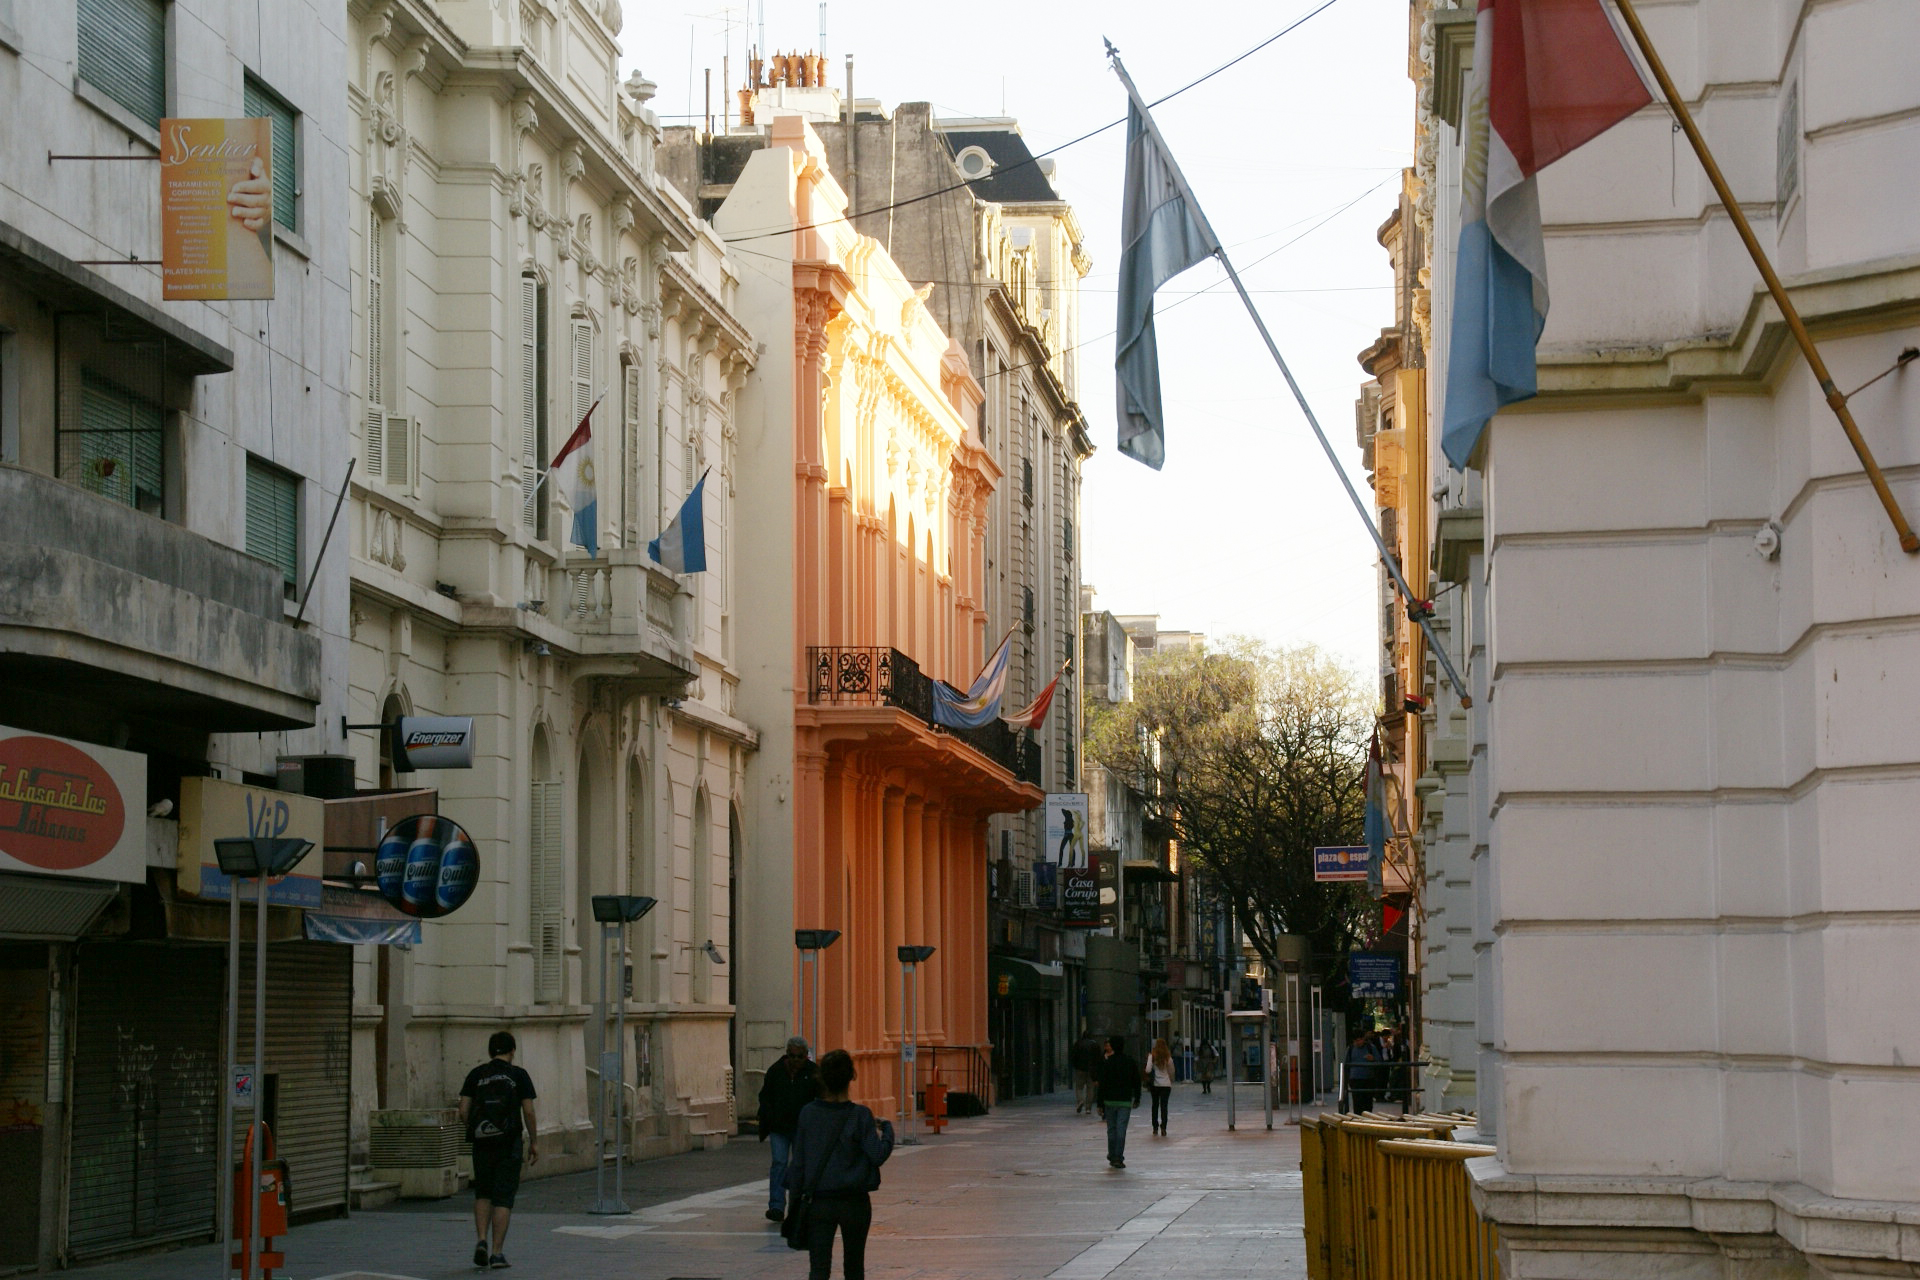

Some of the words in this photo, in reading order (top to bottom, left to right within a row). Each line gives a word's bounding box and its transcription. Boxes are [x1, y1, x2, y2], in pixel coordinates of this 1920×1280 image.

[170, 126, 257, 165] Sentier
[410, 731, 463, 747] Energizer
[15, 768, 57, 804] Casa
[58, 779, 77, 808] de
[1318, 853, 1338, 864] plaza
[1068, 876, 1095, 888] Casa
[1064, 887, 1099, 901] Corujo
